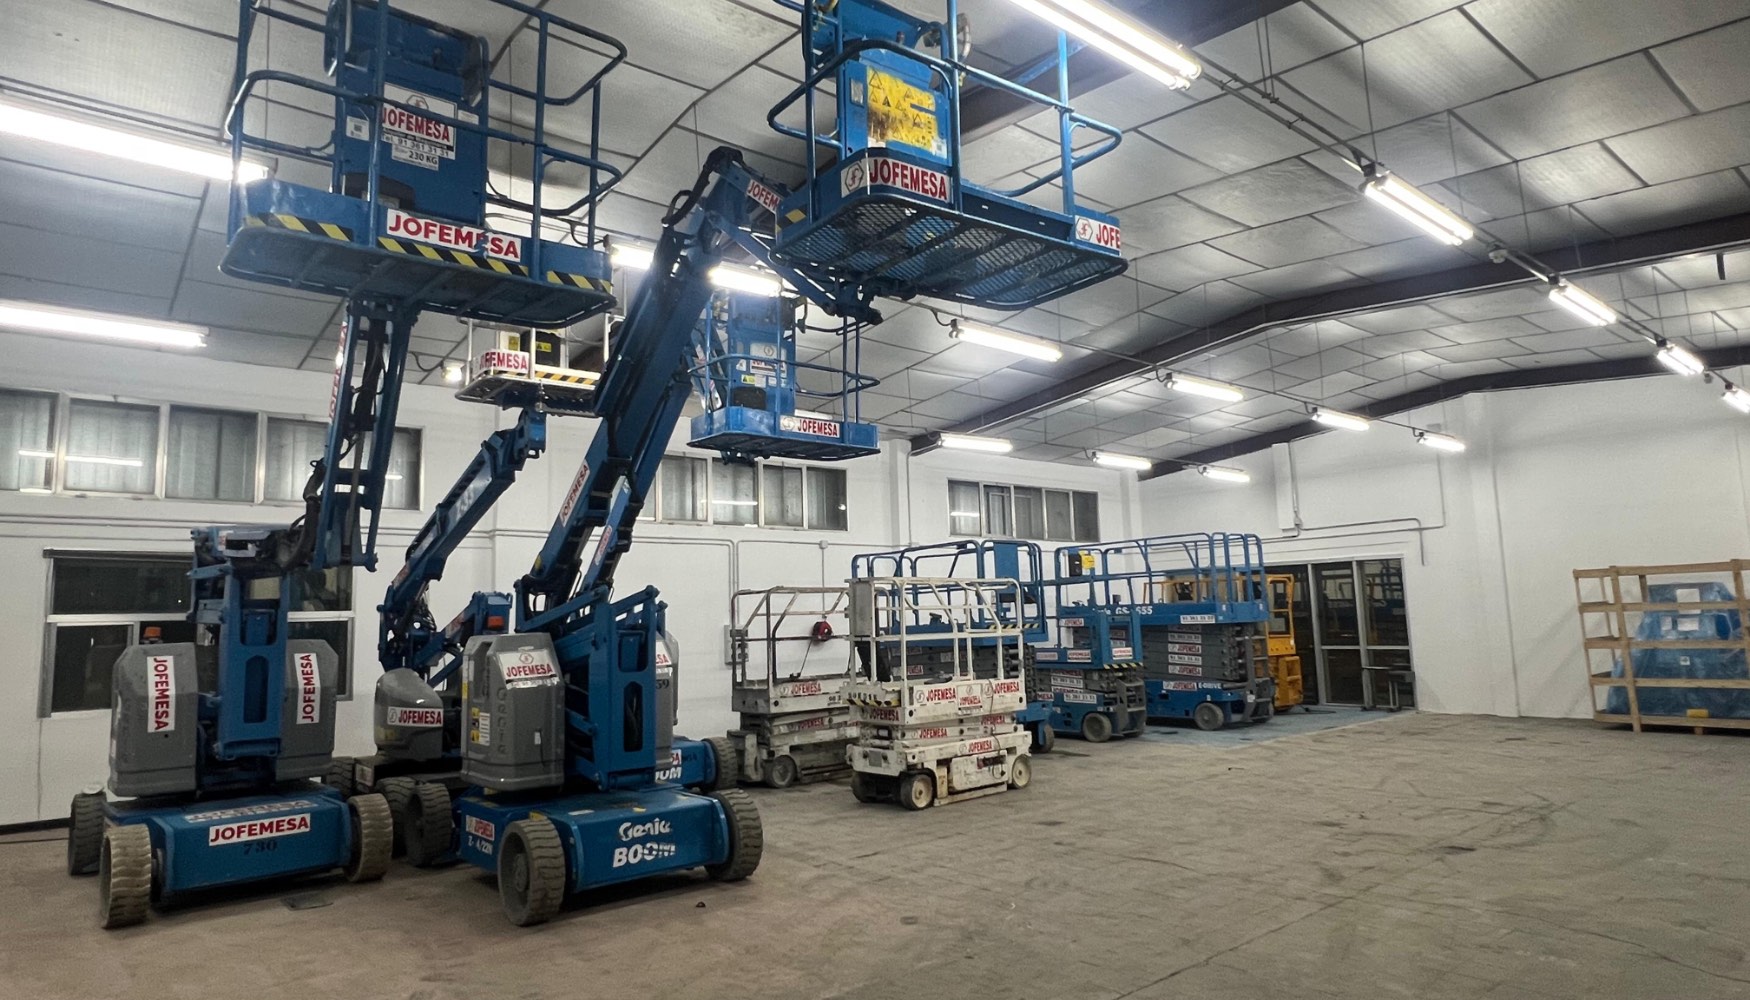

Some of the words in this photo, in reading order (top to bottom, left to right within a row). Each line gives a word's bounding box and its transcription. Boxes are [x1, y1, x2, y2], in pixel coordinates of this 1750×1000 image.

[409, 150, 425, 162] 230
[426, 155, 438, 165] KG
[870, 158, 948, 201] JOFEMESA
[798, 418, 838, 439] JOFEMESA
[507, 663, 553, 677] JOFEMESA
[154, 658, 170, 731] JOFEMESA
[302, 654, 315, 722] JOFEMESA
[791, 683, 822, 695] JOFEMESA
[926, 687, 956, 702] JOFEMESA
[993, 682, 1019, 695] JOFEMESA
[399, 709, 443, 725] JOFEMESA
[919, 728, 948, 739] JOFEMESA
[968, 740, 992, 753] JOFEMESA
[210, 816, 309, 843] JOFEMESA
[613, 843, 676, 868] BOOM
